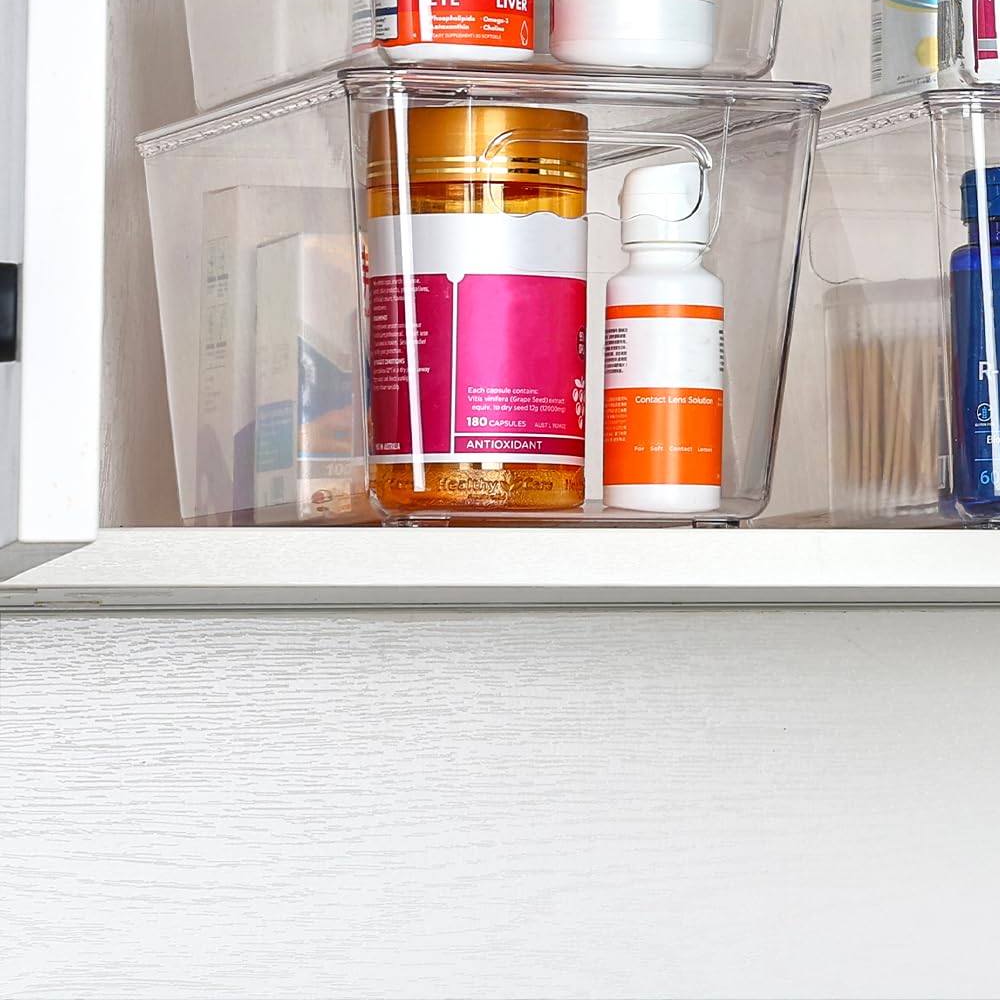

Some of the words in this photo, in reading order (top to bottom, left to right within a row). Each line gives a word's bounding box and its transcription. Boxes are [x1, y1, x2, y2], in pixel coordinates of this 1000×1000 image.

[486, 387, 511, 395] capsule
[509, 396, 530, 404] (Grape
[532, 396, 549, 404] Seed)
[635, 395, 666, 404] Contact
[668, 395, 687, 404] Lens
[688, 396, 713, 405] Solution
[501, 404, 512, 412] dry
[466, 416, 488, 427] 180
[489, 419, 527, 428] CAPSULES
[466, 439, 543, 450] ANTIOXIDANT
[669, 445, 693, 453] Contact
